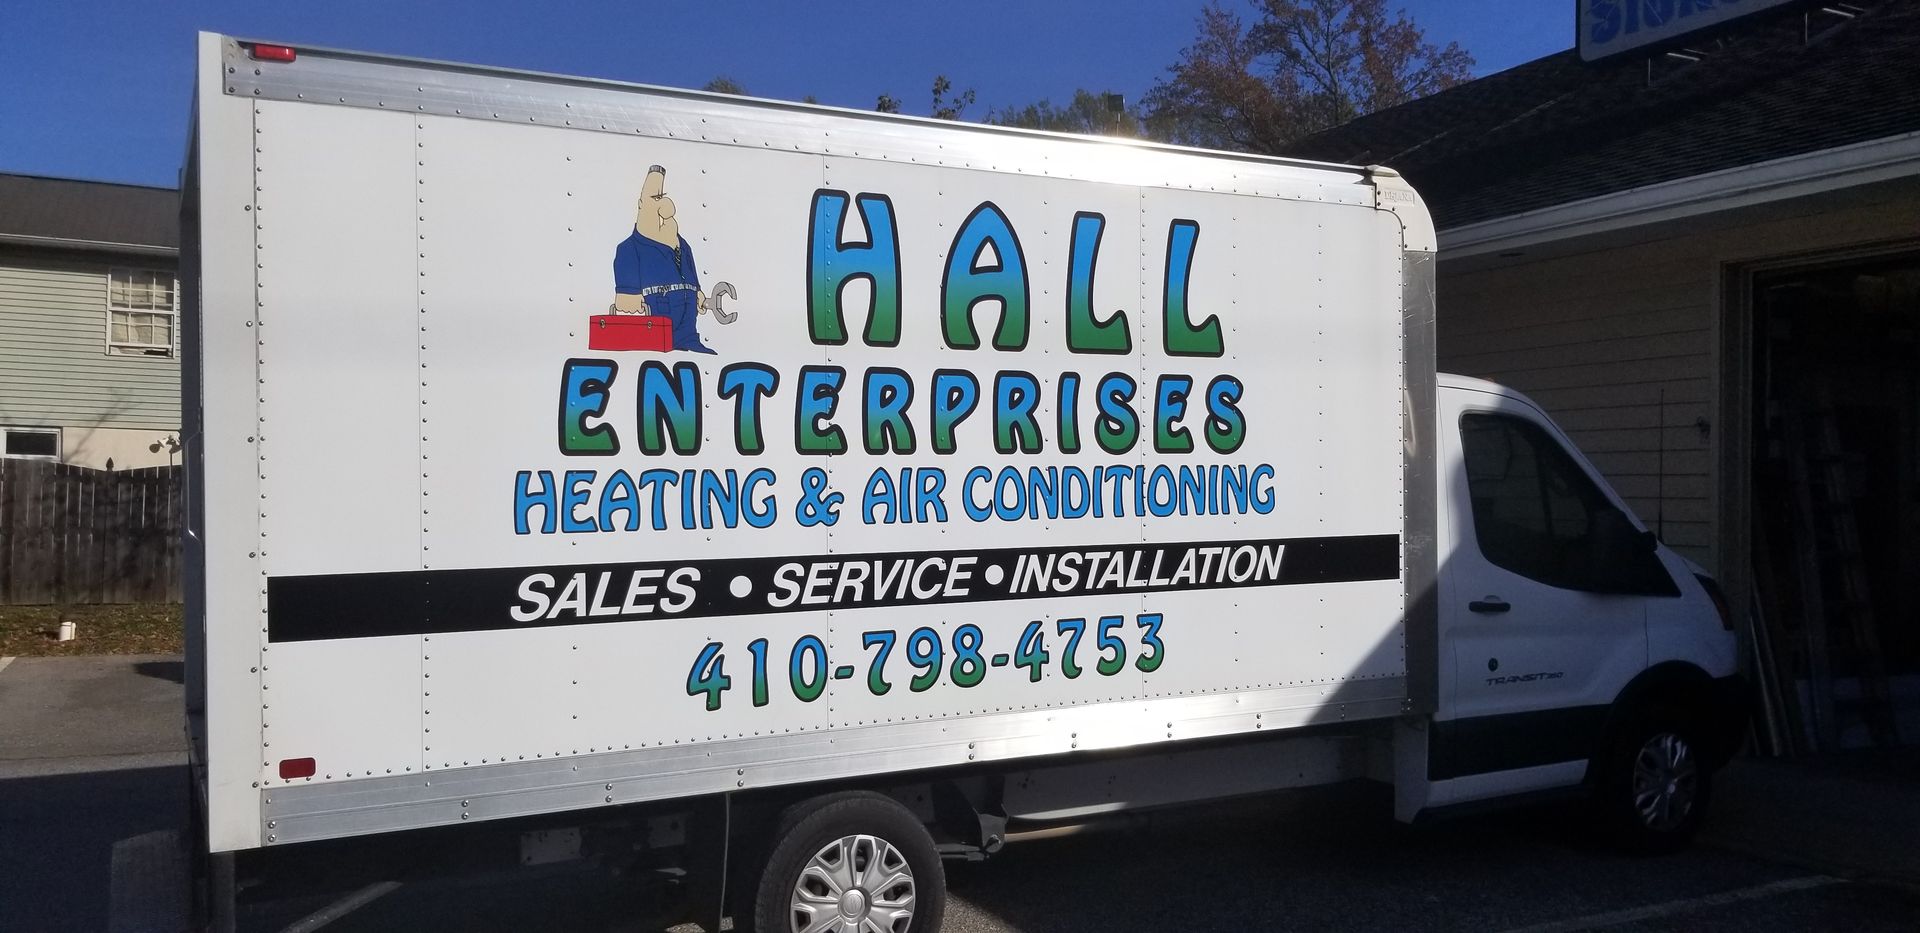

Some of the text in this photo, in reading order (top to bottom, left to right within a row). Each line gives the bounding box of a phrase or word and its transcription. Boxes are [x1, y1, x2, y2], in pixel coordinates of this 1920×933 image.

[806, 188, 1224, 358] HALL
[558, 358, 1247, 455] ENTERPRISES
[514, 464, 1275, 535] HEATING & AIR CONDITIONING
[510, 544, 1285, 622] SALES SERVICE INSTALLATION
[686, 612, 1165, 712] 410-798-4753
[1486, 673, 1545, 686] TRANSIT
